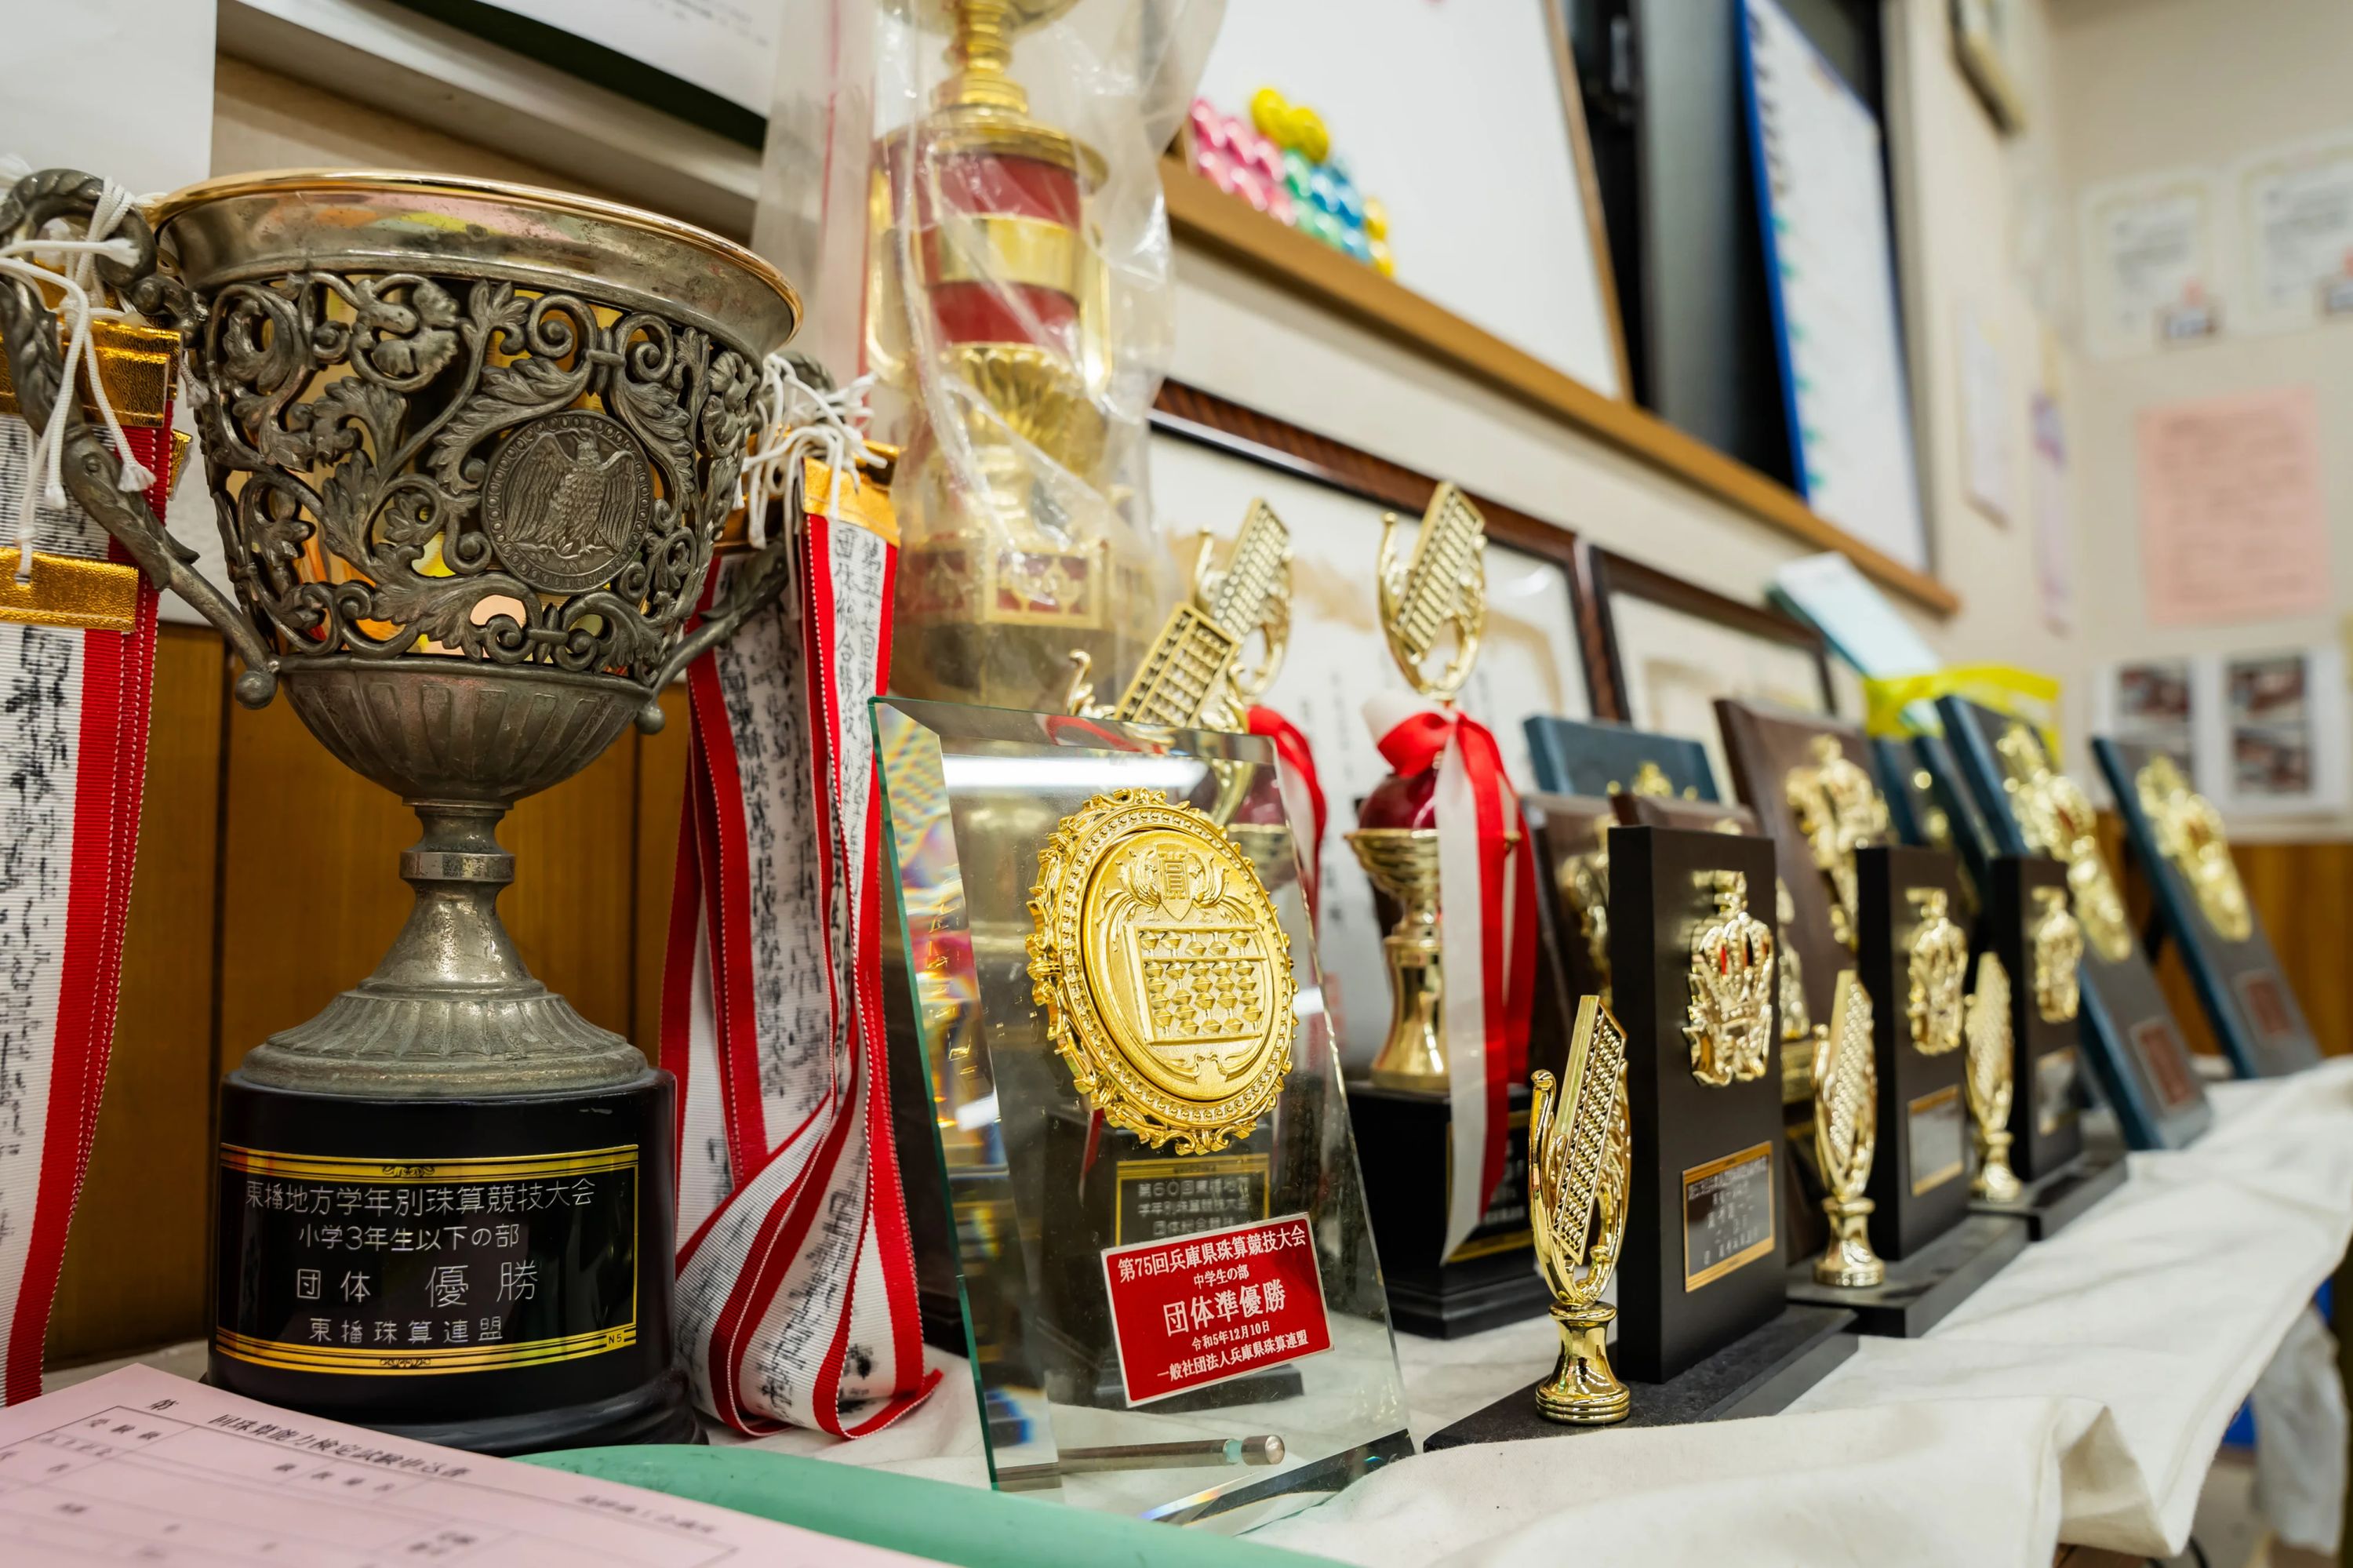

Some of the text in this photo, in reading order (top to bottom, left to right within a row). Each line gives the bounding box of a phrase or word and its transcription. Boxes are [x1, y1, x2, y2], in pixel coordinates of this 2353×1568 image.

[245, 1177, 596, 1217] 東播地方学年別珠算競技大会
[298, 1223, 521, 1252] 小学3年生以下の部
[1117, 1224, 1307, 1283] 第75回兵庫県珠算競技大会
[296, 1259, 539, 1308] 団体 優勝
[1192, 1263, 1250, 1290] 中学生の部
[1162, 1279, 1286, 1337] 団体準優勝
[308, 1315, 504, 1344] 東播珠算連盟
[1191, 1320, 1271, 1352] 令和5年12月10日
[1156, 1329, 1309, 1382] 一般社団法人兵庫県珠算連盟
